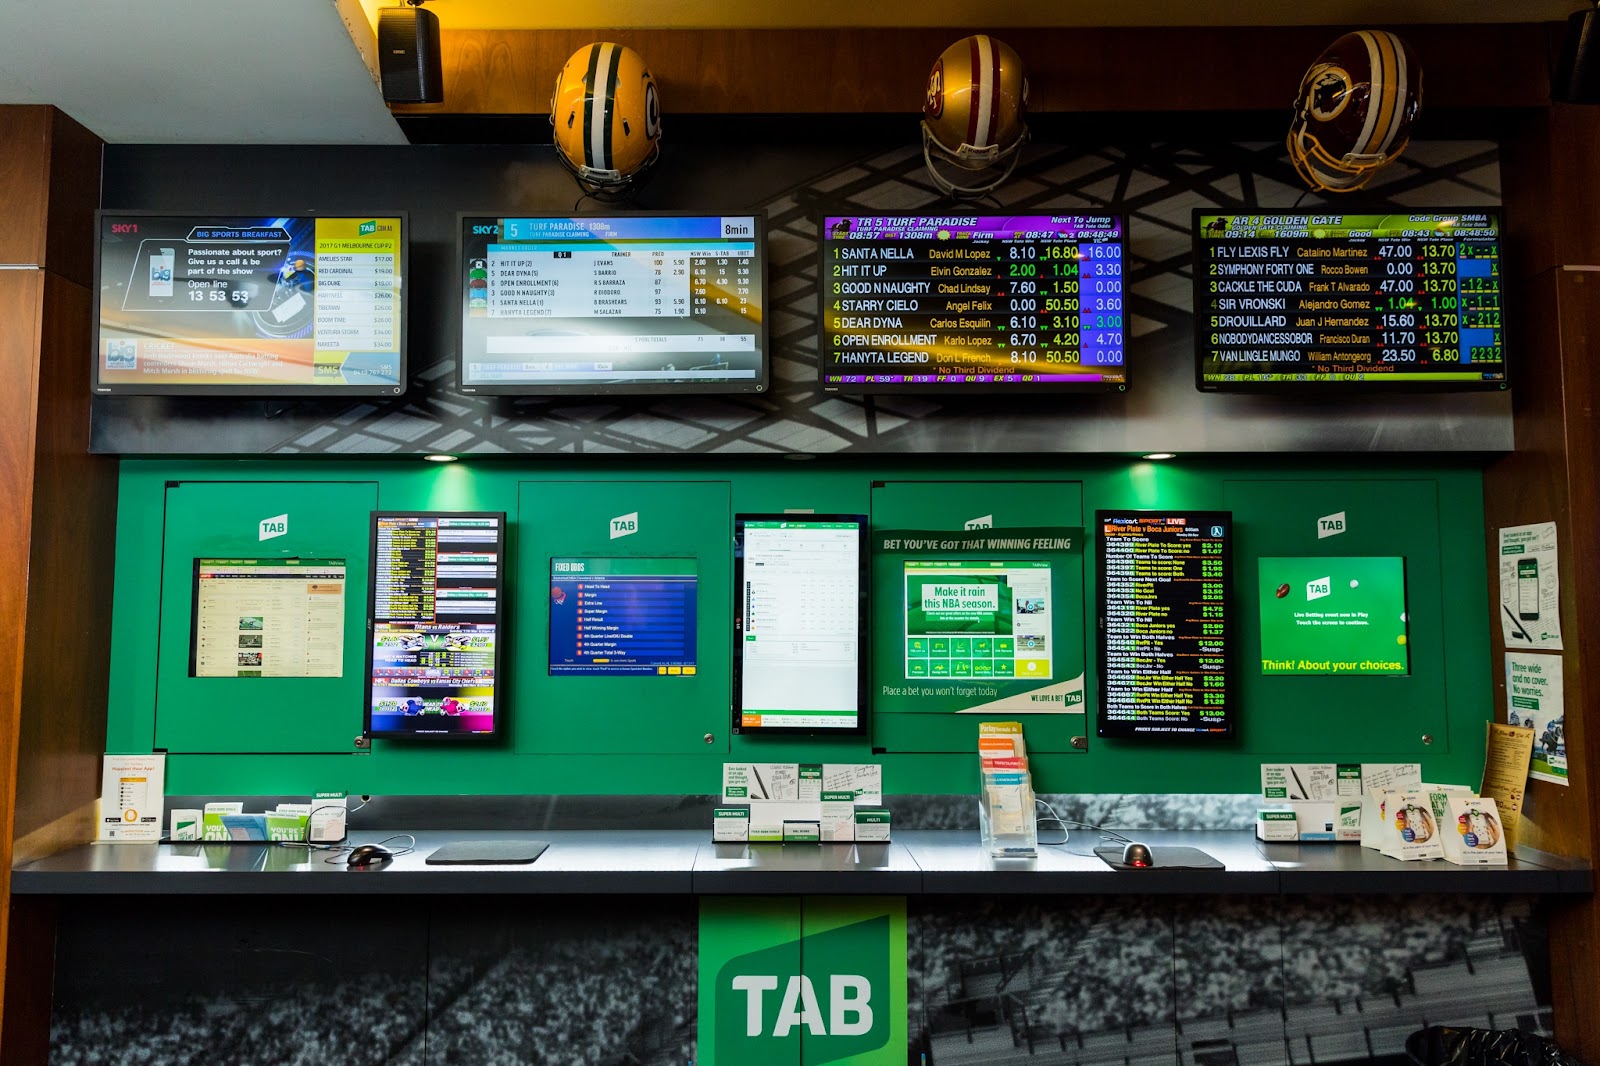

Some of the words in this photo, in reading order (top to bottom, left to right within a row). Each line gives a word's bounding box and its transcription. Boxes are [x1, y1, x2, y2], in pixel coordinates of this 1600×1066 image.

[858, 218, 872, 226] TR
[875, 218, 883, 226] 5
[885, 218, 916, 226] TURF
[919, 218, 977, 226] PARADISE
[1086, 216, 1111, 225] Jump
[1232, 217, 1249, 225] AR
[1252, 217, 1259, 225] 4
[1263, 217, 1309, 225] GOLDEN
[1312, 216, 1342, 224] GATE
[1433, 215, 1459, 223] Group
[360, 224, 376, 232] TAB
[510, 225, 518, 237] 5
[725, 224, 748, 235] 8min
[850, 232, 880, 240] 08:57
[899, 232, 933, 240] 1308m
[1026, 231, 1054, 239] 08:47
[1078, 231, 1118, 239] 08:48:49
[1225, 230, 1255, 238] 09:14
[1274, 230, 1308, 238] 1609m
[1454, 229, 1495, 237] 08:48:50
[188, 248, 230, 256] Passionate
[233, 248, 255, 256] about
[258, 248, 282, 257] sport?
[842, 248, 877, 259] SANTA
[880, 248, 914, 259] NELLA
[1217, 247, 1236, 257] FLY
[1238, 247, 1268, 257] LEXIS
[1270, 246, 1289, 257] FLY
[188, 268, 204, 276] part
[842, 266, 858, 276] HIT
[861, 266, 870, 276] IT
[872, 266, 887, 276] UP
[188, 280, 209, 289] Open
[212, 280, 227, 288] line
[842, 283, 871, 294] GOOD
[874, 283, 881, 294] N
[883, 283, 930, 294] NAUGHTY
[1218, 281, 1253, 292] CACKLE
[1255, 281, 1274, 292] THE
[1276, 281, 1302, 292] CUDA
[189, 291, 203, 301] 13
[209, 291, 226, 301] 53
[232, 291, 249, 302] 53
[842, 300, 884, 311] STARRY
[886, 300, 918, 311] CIELO
[1219, 299, 1236, 310] SIR
[1239, 299, 1286, 310] VRONSKI
[842, 318, 871, 328] DEAR
[874, 318, 903, 328] DYNA
[1219, 316, 1287, 327] DROUILLARD
[842, 335, 870, 346] OPEN
[872, 335, 937, 346] ENROLLMENT
[842, 352, 885, 363] HANYTA
[888, 352, 929, 363] LEGEND
[262, 521, 285, 533] TAB
[613, 521, 635, 531] TAB
[1320, 521, 1343, 530] TAB
[883, 540, 901, 549] BET
[904, 540, 938, 549] YOU'VE
[940, 540, 959, 549] GOT
[962, 539, 985, 549] THAT
[987, 539, 1030, 549] WINNING
[1033, 539, 1071, 549] FEELING
[555, 563, 570, 572] FIXED
[571, 563, 584, 572] ODDS
[935, 587, 958, 596] Make
[960, 587, 967, 596] it
[968, 587, 985, 596] rain
[1309, 585, 1328, 593] TAB
[924, 599, 940, 608] this
[942, 600, 960, 609] NBA
[962, 600, 995, 609] season.
[1262, 660, 1295, 669] Think!
[1298, 660, 1330, 669] About
[1333, 662, 1357, 672] your
[1360, 660, 1404, 669] choices.
[1512, 662, 1527, 673] Three
[1528, 663, 1541, 674] wide
[1513, 674, 1523, 683] and
[1532, 677, 1548, 686] cover.
[883, 686, 900, 696] Place
[907, 686, 919, 695] bet
[921, 688, 934, 697] you
[936, 686, 954, 696] won't
[956, 686, 977, 697] forget
[978, 686, 997, 696] today
[1513, 684, 1520, 694] No
[1522, 687, 1544, 697] worries.
[732, 975, 873, 1036] TAB
